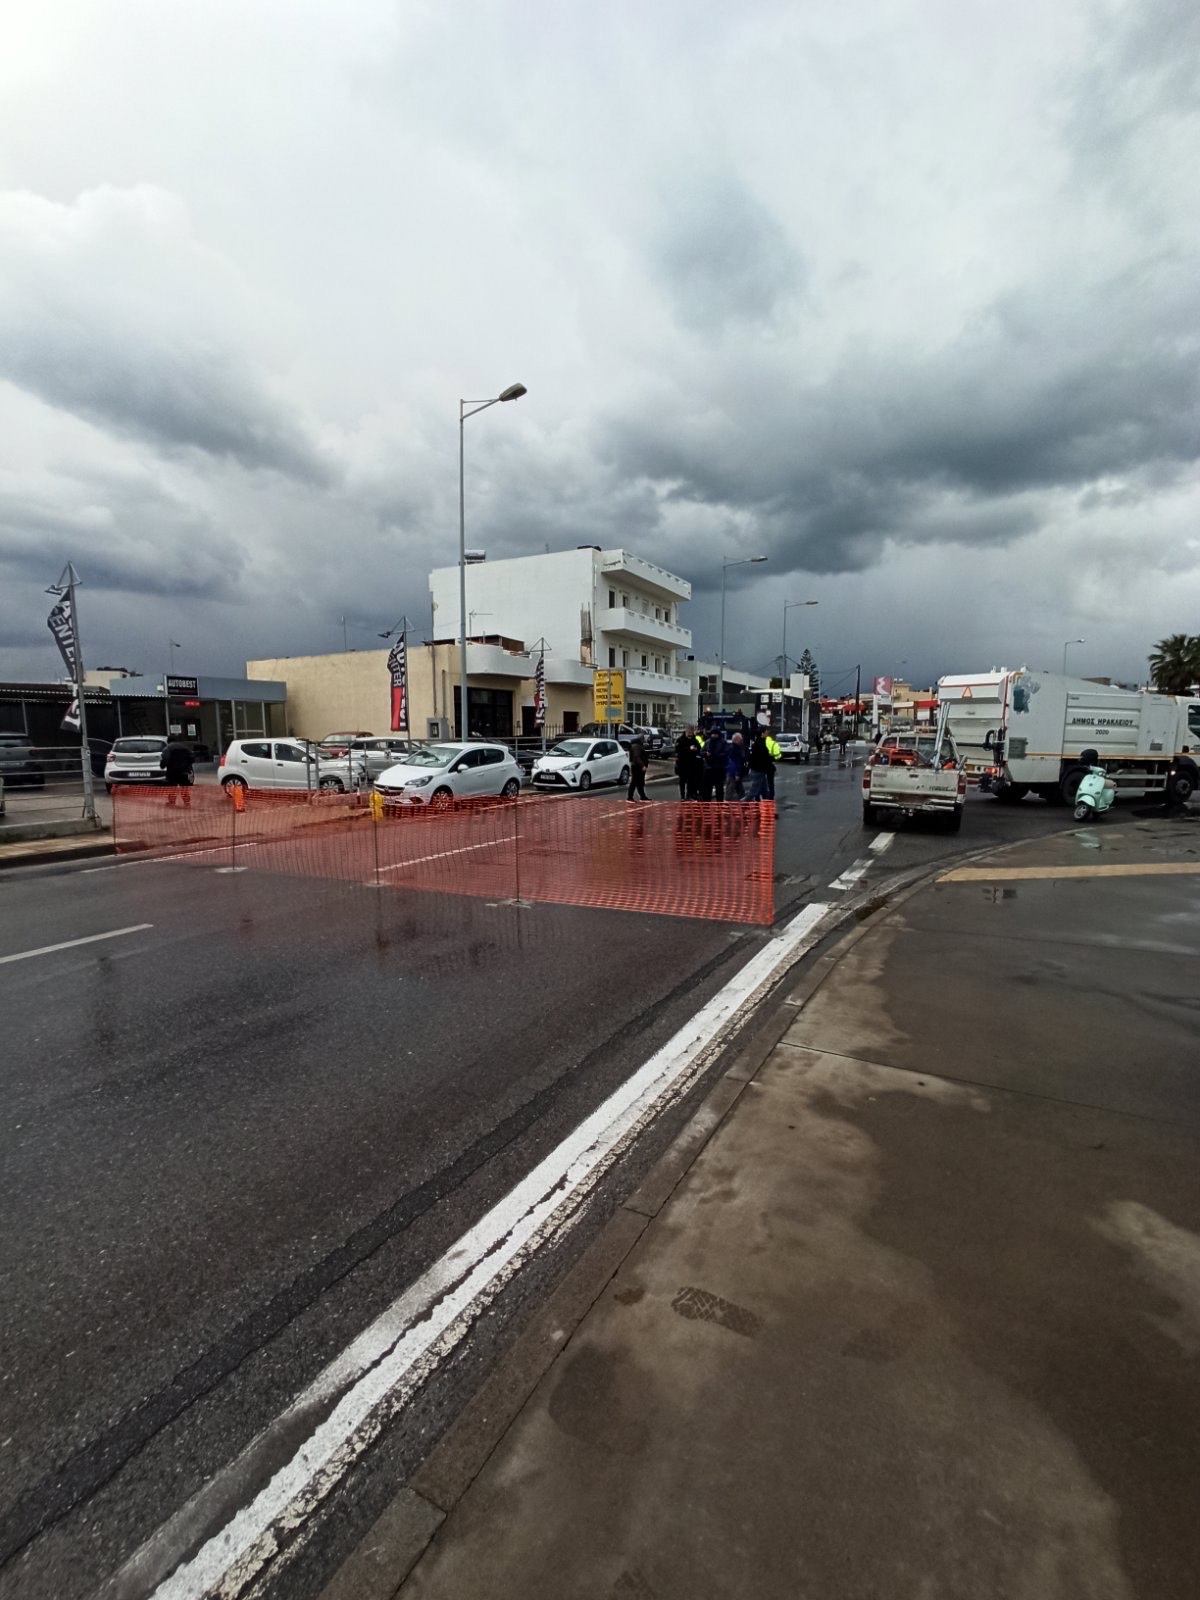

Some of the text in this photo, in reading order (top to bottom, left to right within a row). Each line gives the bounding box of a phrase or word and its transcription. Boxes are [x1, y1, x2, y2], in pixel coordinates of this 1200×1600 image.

[168, 679, 196, 688] AUTOBEST
[1071, 717, 1134, 727] ΔΗΜΟΣ ΗΡΑΚΛΕΙΟΥ
